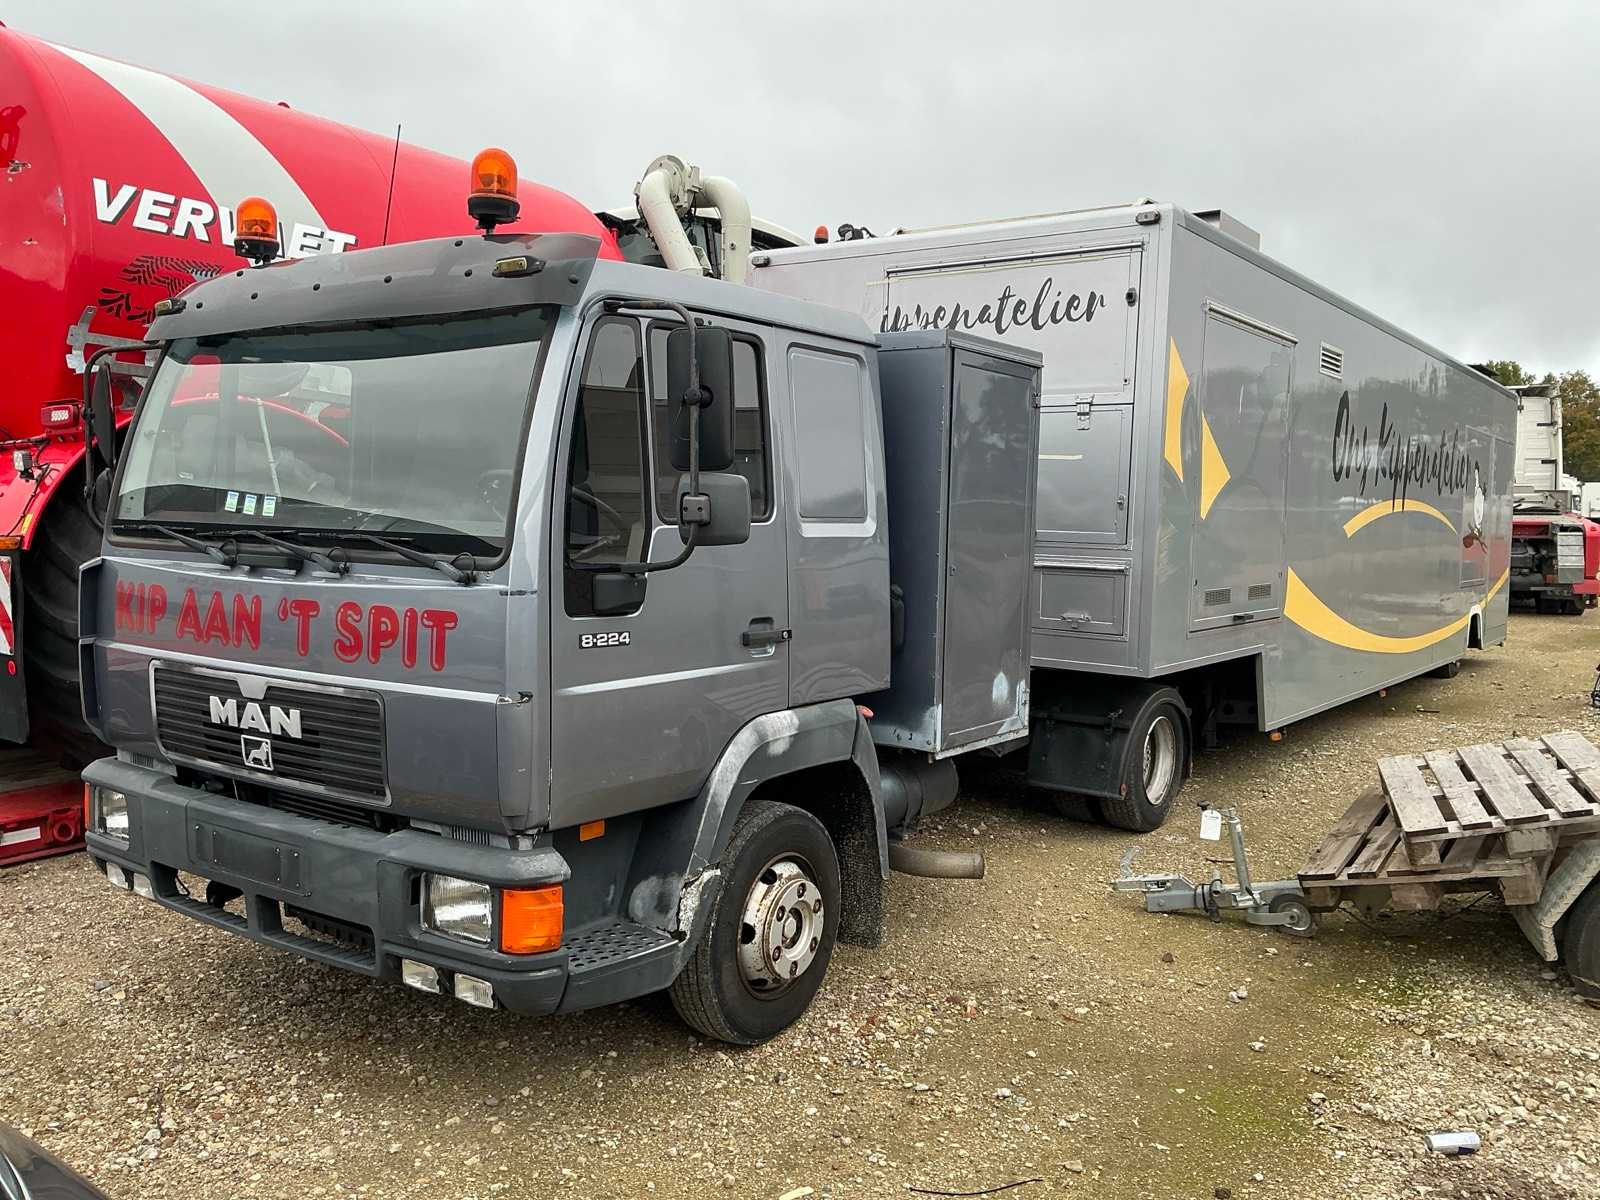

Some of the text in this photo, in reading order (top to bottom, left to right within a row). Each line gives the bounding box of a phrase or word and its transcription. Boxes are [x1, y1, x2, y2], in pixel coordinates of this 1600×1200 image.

[92, 176, 358, 267] VERVET
[1374, 402, 1471, 512] Kippenatelier
[115, 579, 168, 635] KIP
[175, 586, 262, 650] AAN
[333, 601, 459, 672] SPIT
[209, 695, 303, 739] MAN
